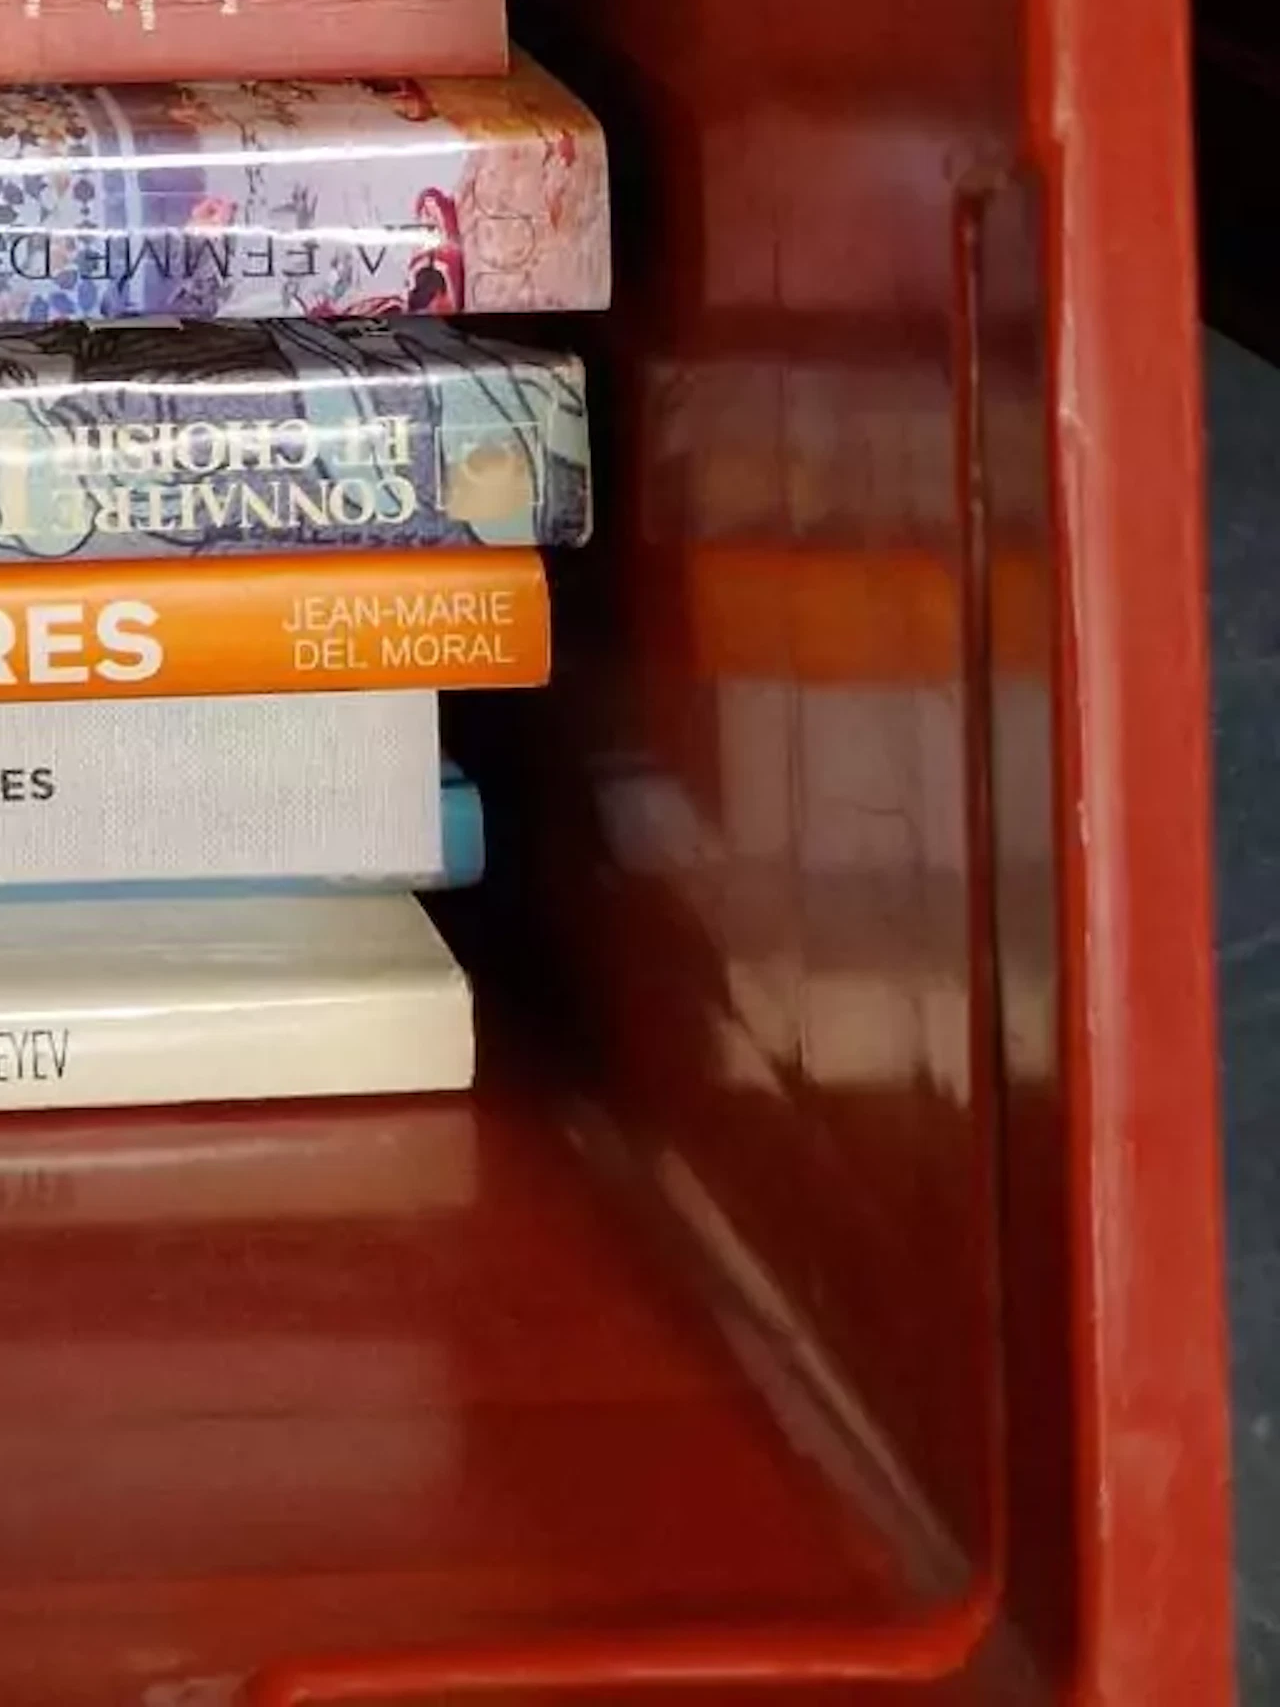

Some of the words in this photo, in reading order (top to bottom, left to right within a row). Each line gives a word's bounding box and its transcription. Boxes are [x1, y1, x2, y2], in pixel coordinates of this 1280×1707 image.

[96, 226, 320, 282] FEMME
[282, 591, 514, 634] JEAN-MARIE
[293, 637, 368, 673] DEL
[380, 634, 515, 669] MORAL
